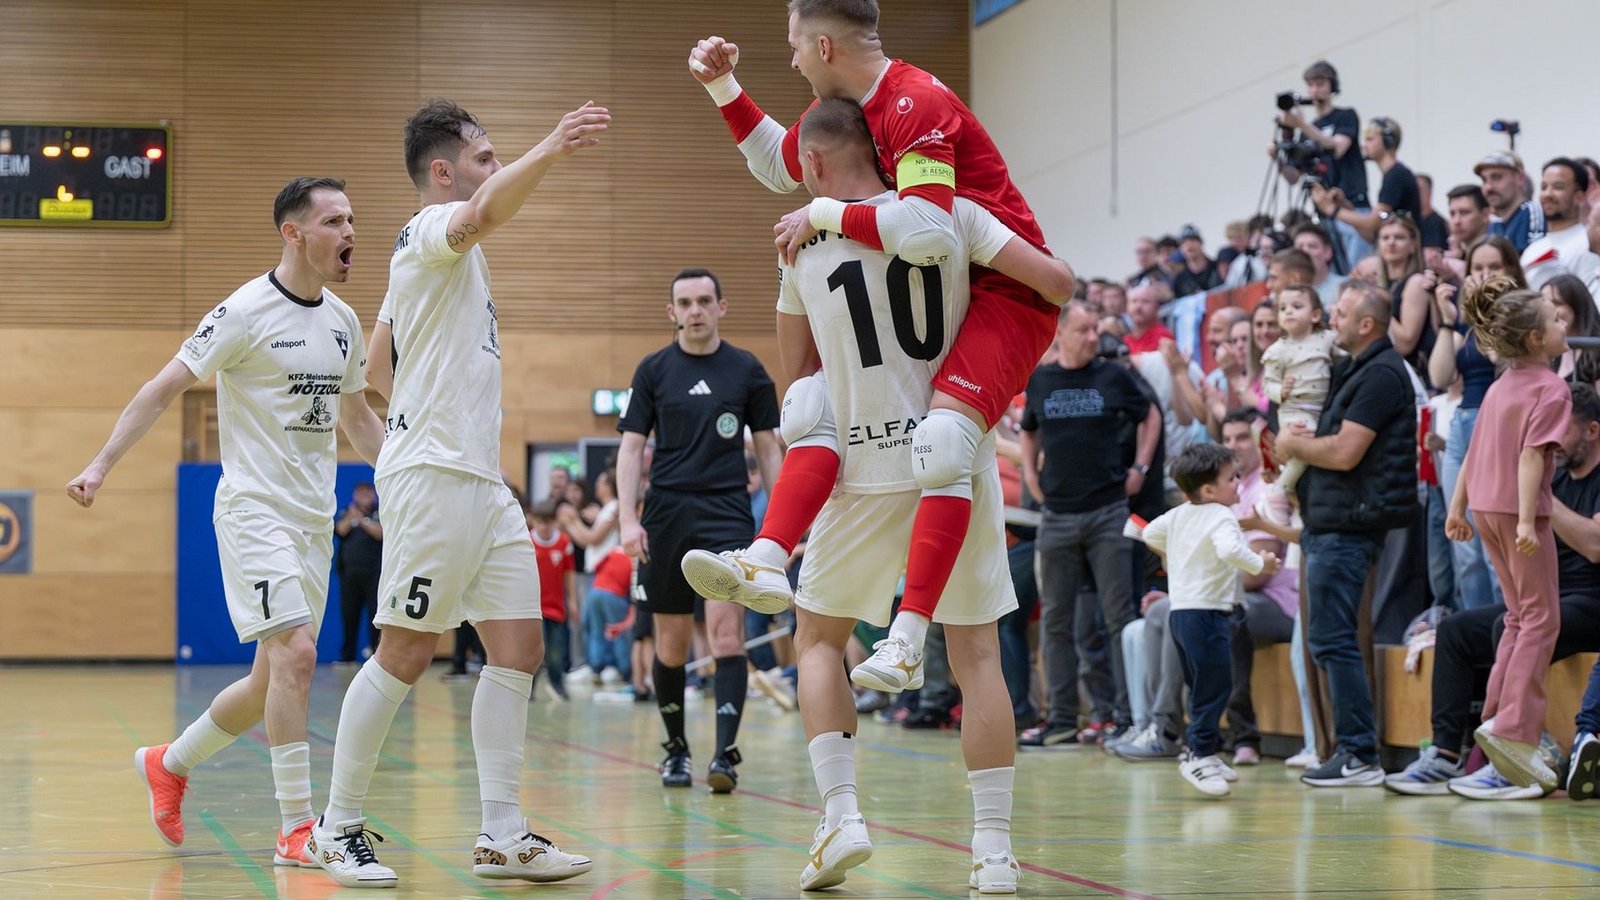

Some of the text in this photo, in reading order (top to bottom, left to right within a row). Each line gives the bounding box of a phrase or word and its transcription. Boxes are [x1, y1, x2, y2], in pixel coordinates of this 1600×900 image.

[104, 155, 151, 179] GAST
[827, 254, 945, 369] 10
[271, 339, 306, 349] uhlsport
[947, 374, 982, 394] uhlsport
[847, 415, 928, 446] ELFA
[913, 444, 933, 455] PLESS
[919, 457, 926, 470] 1
[404, 575, 433, 620] 5
